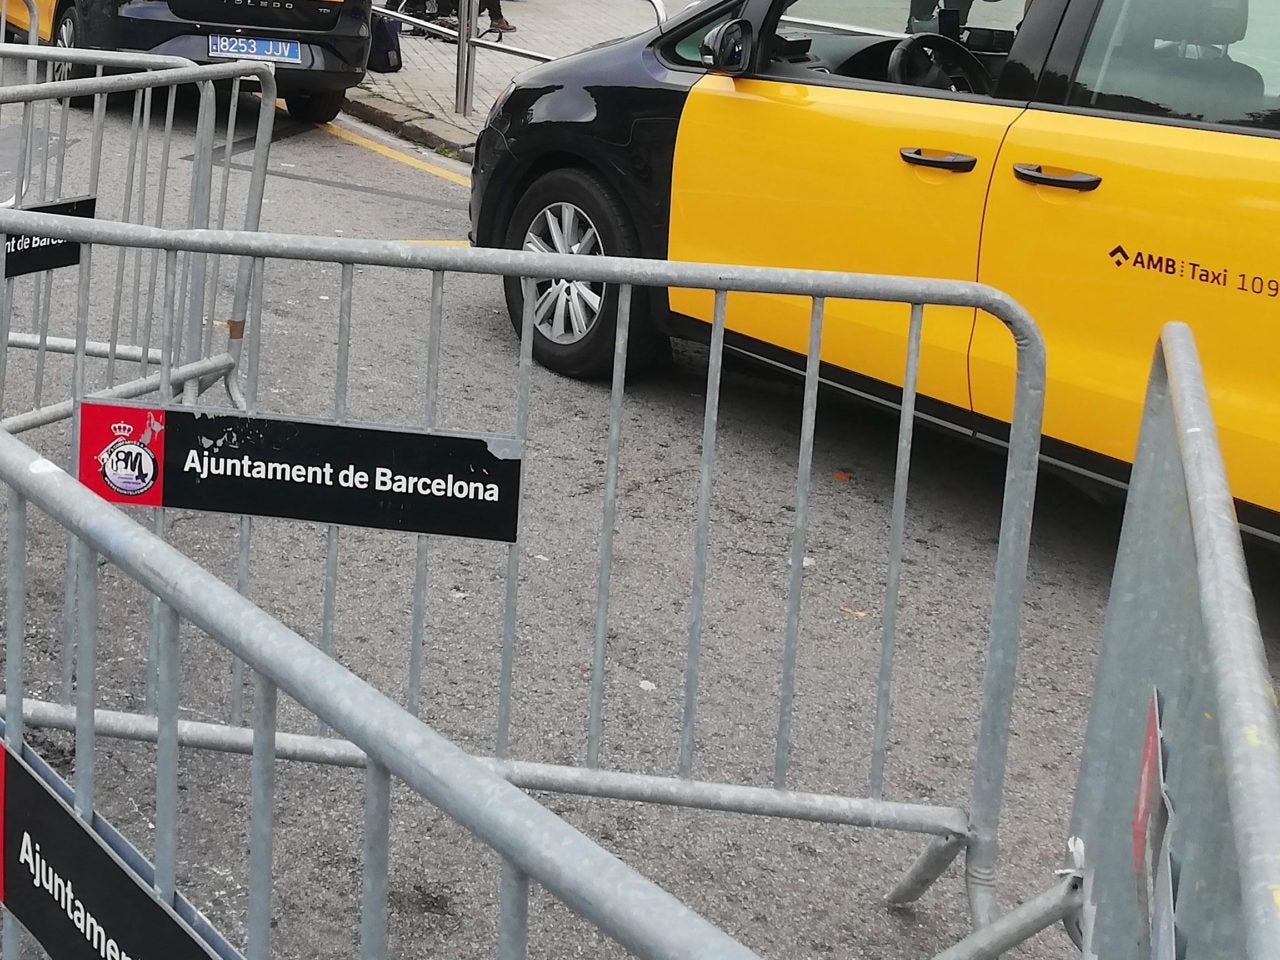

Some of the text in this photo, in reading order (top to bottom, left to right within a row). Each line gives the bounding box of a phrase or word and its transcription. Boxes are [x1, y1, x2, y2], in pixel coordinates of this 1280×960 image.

[220, 37, 291, 57] 8253 JJV
[17, 234, 30, 250] de
[1132, 251, 1176, 275] AMB
[1188, 262, 1228, 287] Taxi
[183, 449, 333, 486] Ajuntament
[338, 464, 369, 489] de
[374, 467, 499, 502] Barcelona
